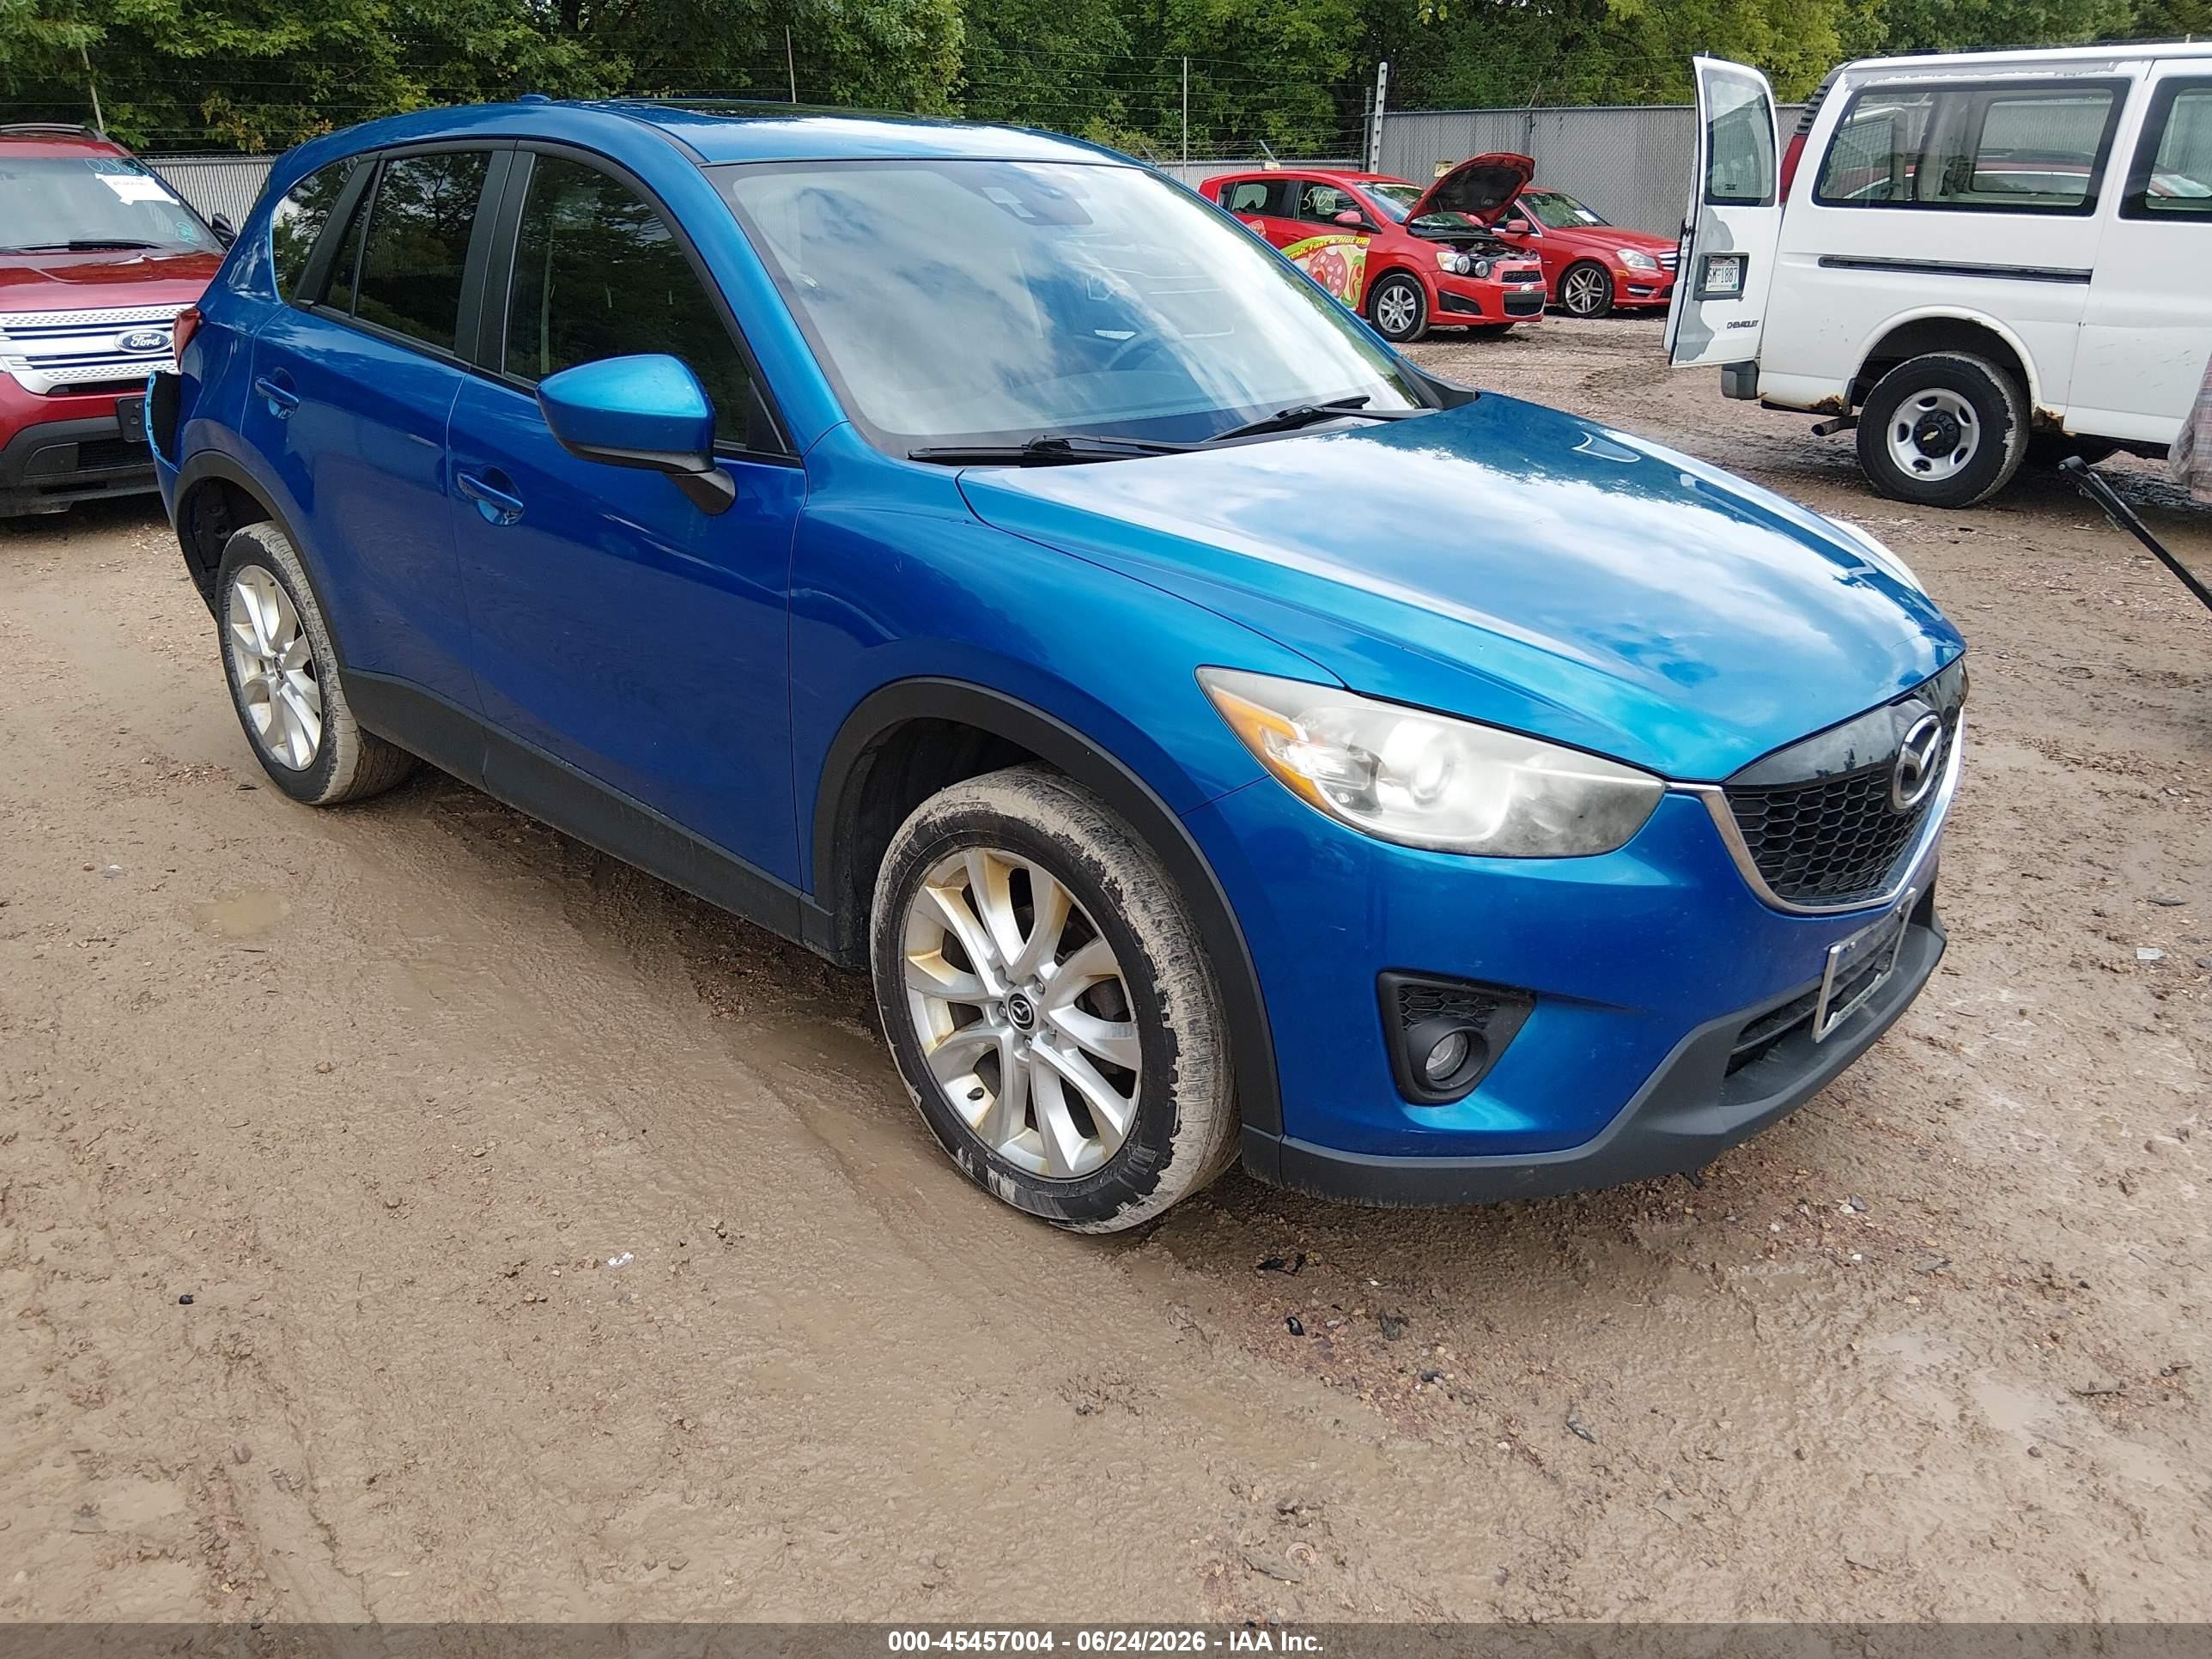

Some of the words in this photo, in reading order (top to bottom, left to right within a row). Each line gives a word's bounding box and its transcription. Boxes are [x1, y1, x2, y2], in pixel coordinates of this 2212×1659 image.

[1301, 188, 1337, 211] 5105
[1287, 246, 1310, 259] resh,
[1310, 239, 1329, 251] Fast
[131, 333, 161, 348] Ford
